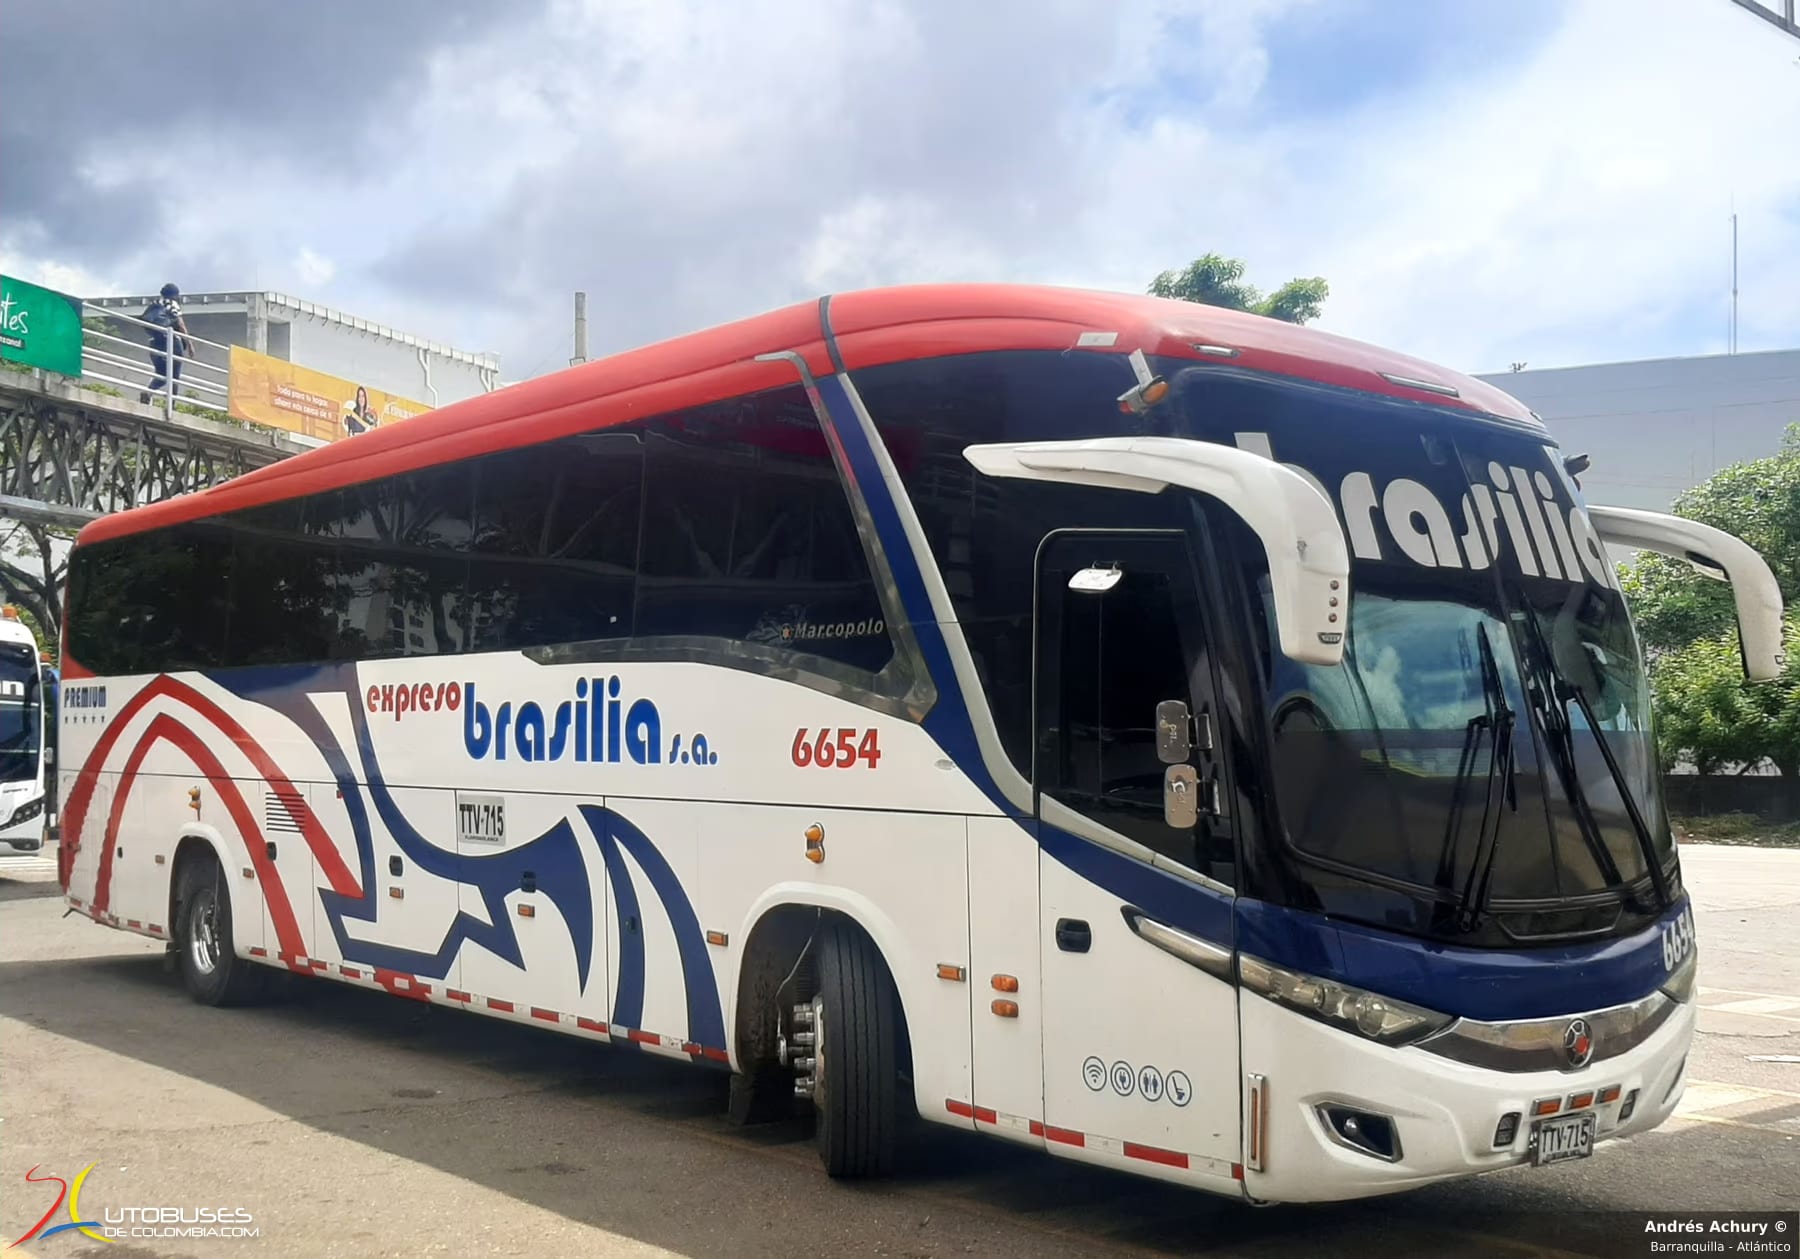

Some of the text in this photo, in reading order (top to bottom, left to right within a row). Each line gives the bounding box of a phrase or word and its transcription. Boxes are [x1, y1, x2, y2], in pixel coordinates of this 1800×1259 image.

[0, 292, 28, 334] tes
[795, 618, 884, 639] Marcopolo
[64, 686, 106, 708] PREMIUM
[367, 675, 719, 766] expreso brasilia s.a.
[791, 728, 881, 769] 6654
[459, 803, 504, 837] TTV-715
[1662, 905, 1694, 972] 6654
[1541, 1121, 1590, 1152] TTV-715
